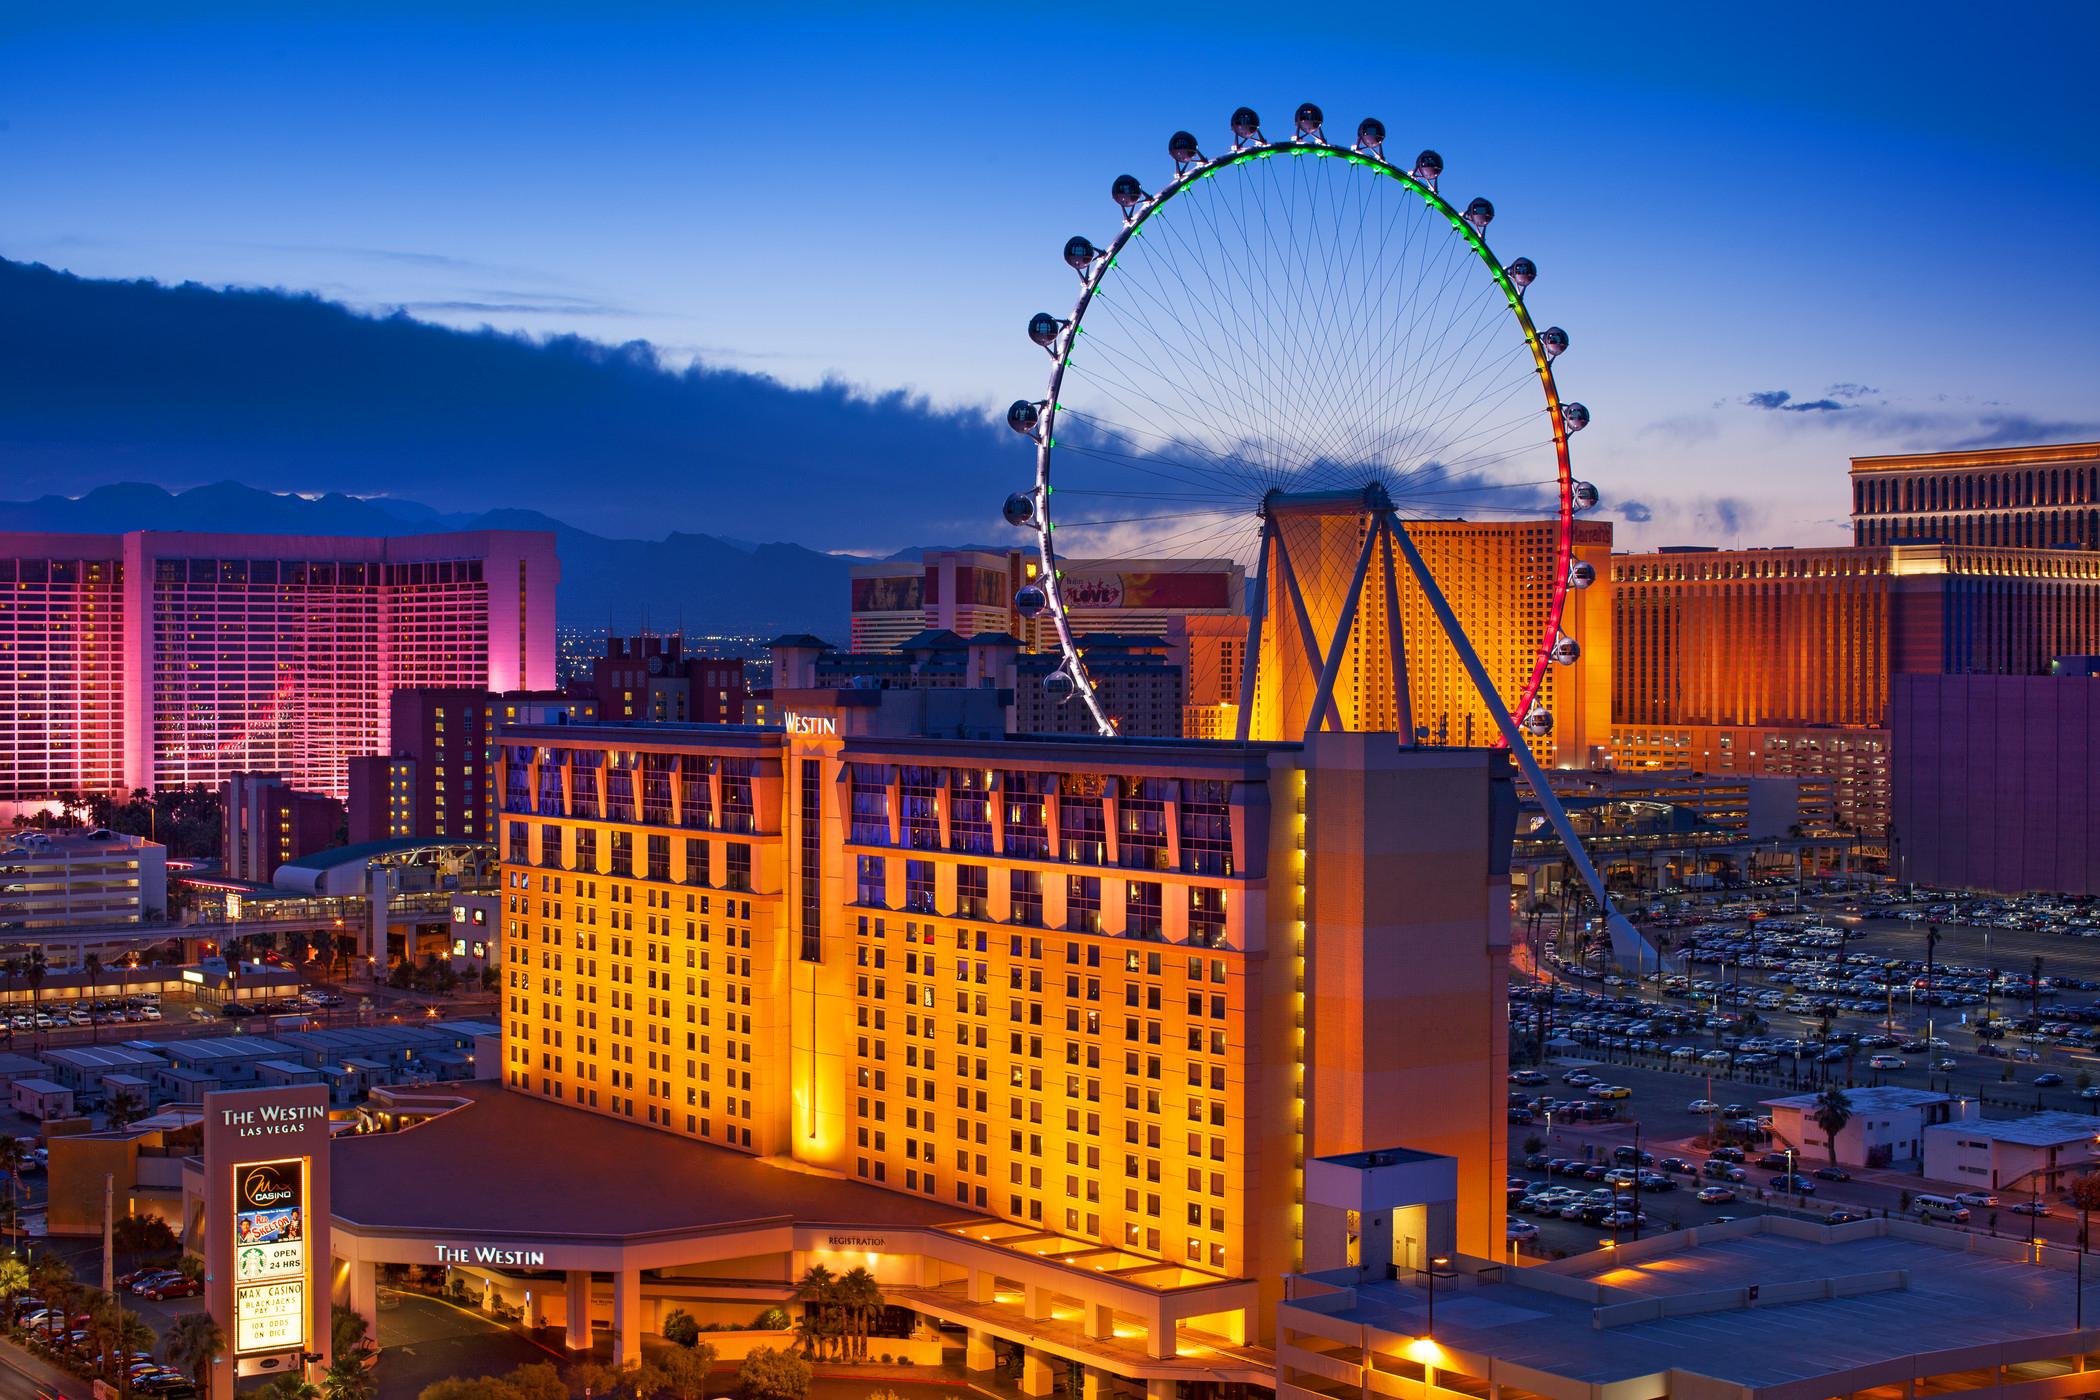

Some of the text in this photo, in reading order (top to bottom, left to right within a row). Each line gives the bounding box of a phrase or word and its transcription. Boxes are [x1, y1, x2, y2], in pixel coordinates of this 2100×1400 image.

[1072, 588, 1110, 603] LOVE
[784, 711, 837, 735] WESTIN
[221, 1105, 324, 1126] THE WESTIN
[240, 1123, 305, 1137] LAS VEGAS
[255, 1190, 292, 1201] CASINO
[251, 1216, 290, 1239] SKELTON
[828, 1236, 887, 1246] REGISTRATION
[273, 1249, 297, 1258] OPEN
[434, 1244, 545, 1265] THE WESTIN
[270, 1259, 301, 1270] 24 HRS
[239, 1284, 301, 1300] MAX CASINO
[245, 1296, 296, 1309] BLACKJACKS
[252, 1319, 289, 1330] 10X ODDS
[254, 1328, 286, 1339] ON DICE
